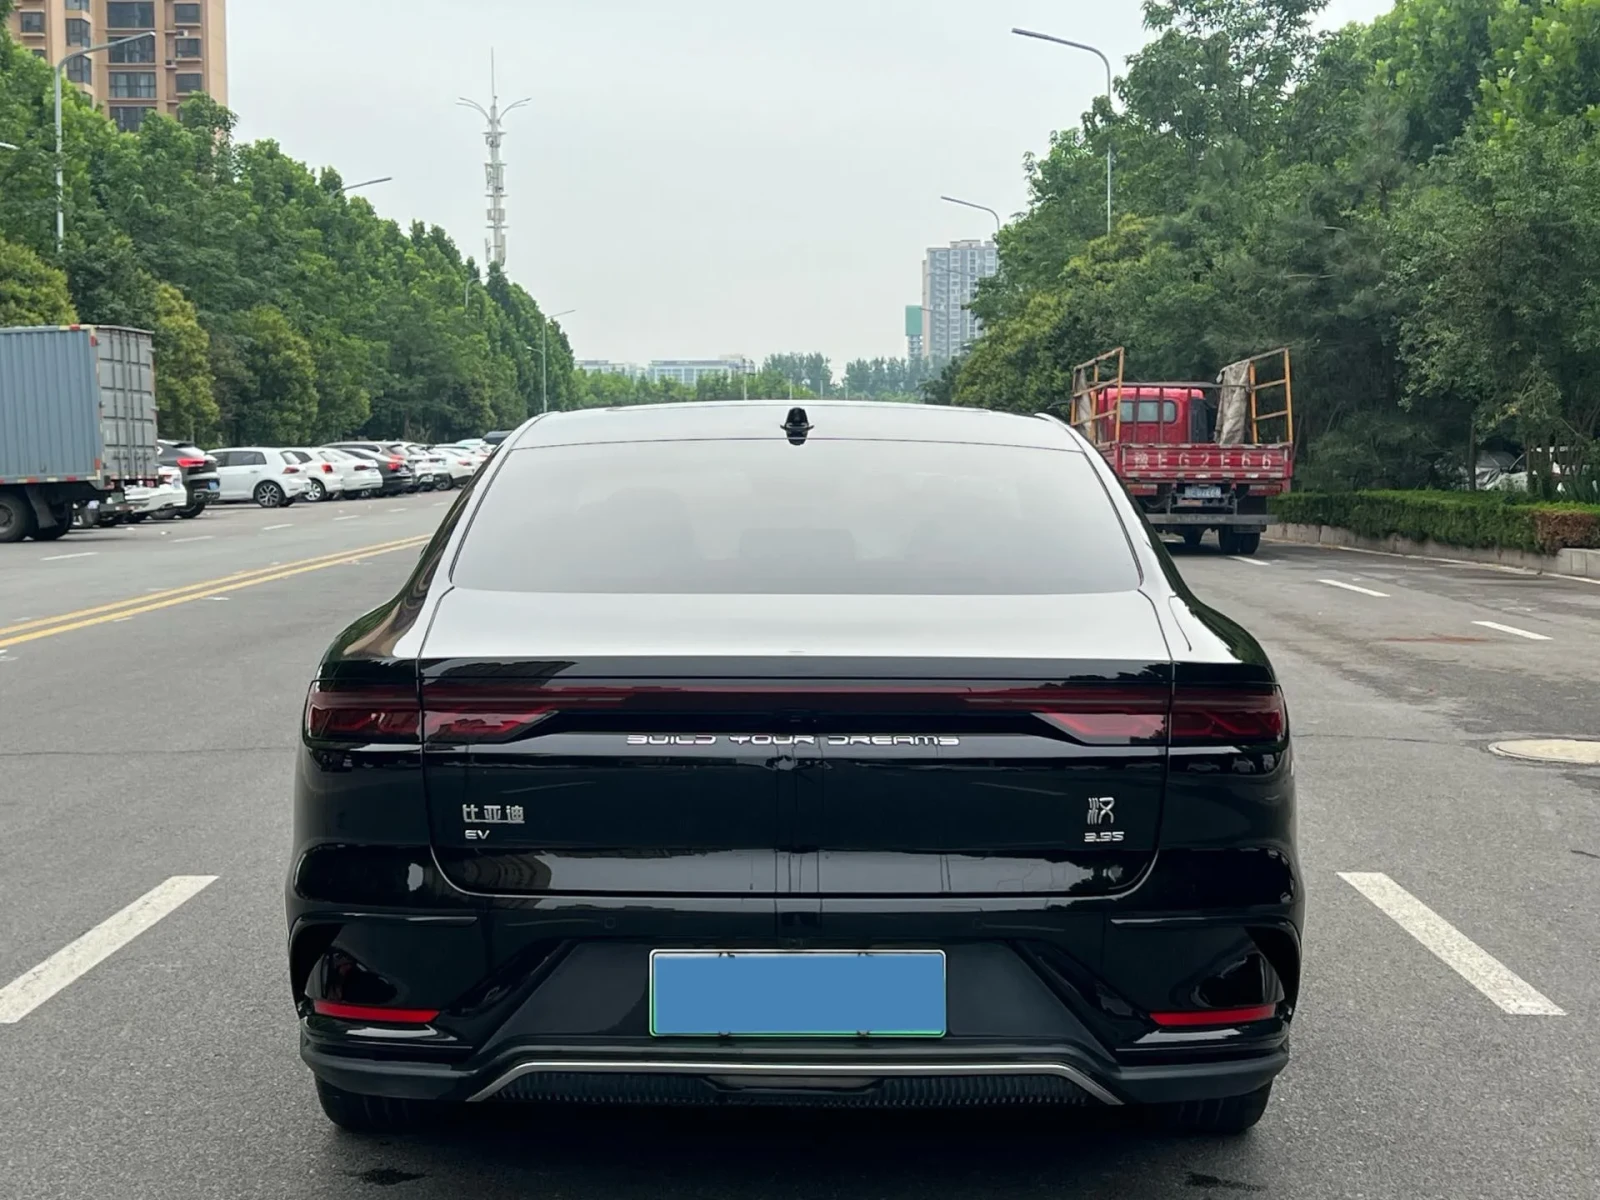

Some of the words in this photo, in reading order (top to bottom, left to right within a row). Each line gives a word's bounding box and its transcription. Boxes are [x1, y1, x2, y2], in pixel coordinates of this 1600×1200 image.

[626, 734, 717, 745] BUILD
[729, 734, 815, 745] YOUR
[826, 734, 961, 746] DREAMS
[462, 804, 526, 824] 比亚迪
[1087, 796, 1115, 825] 汉
[465, 829, 490, 840] EV
